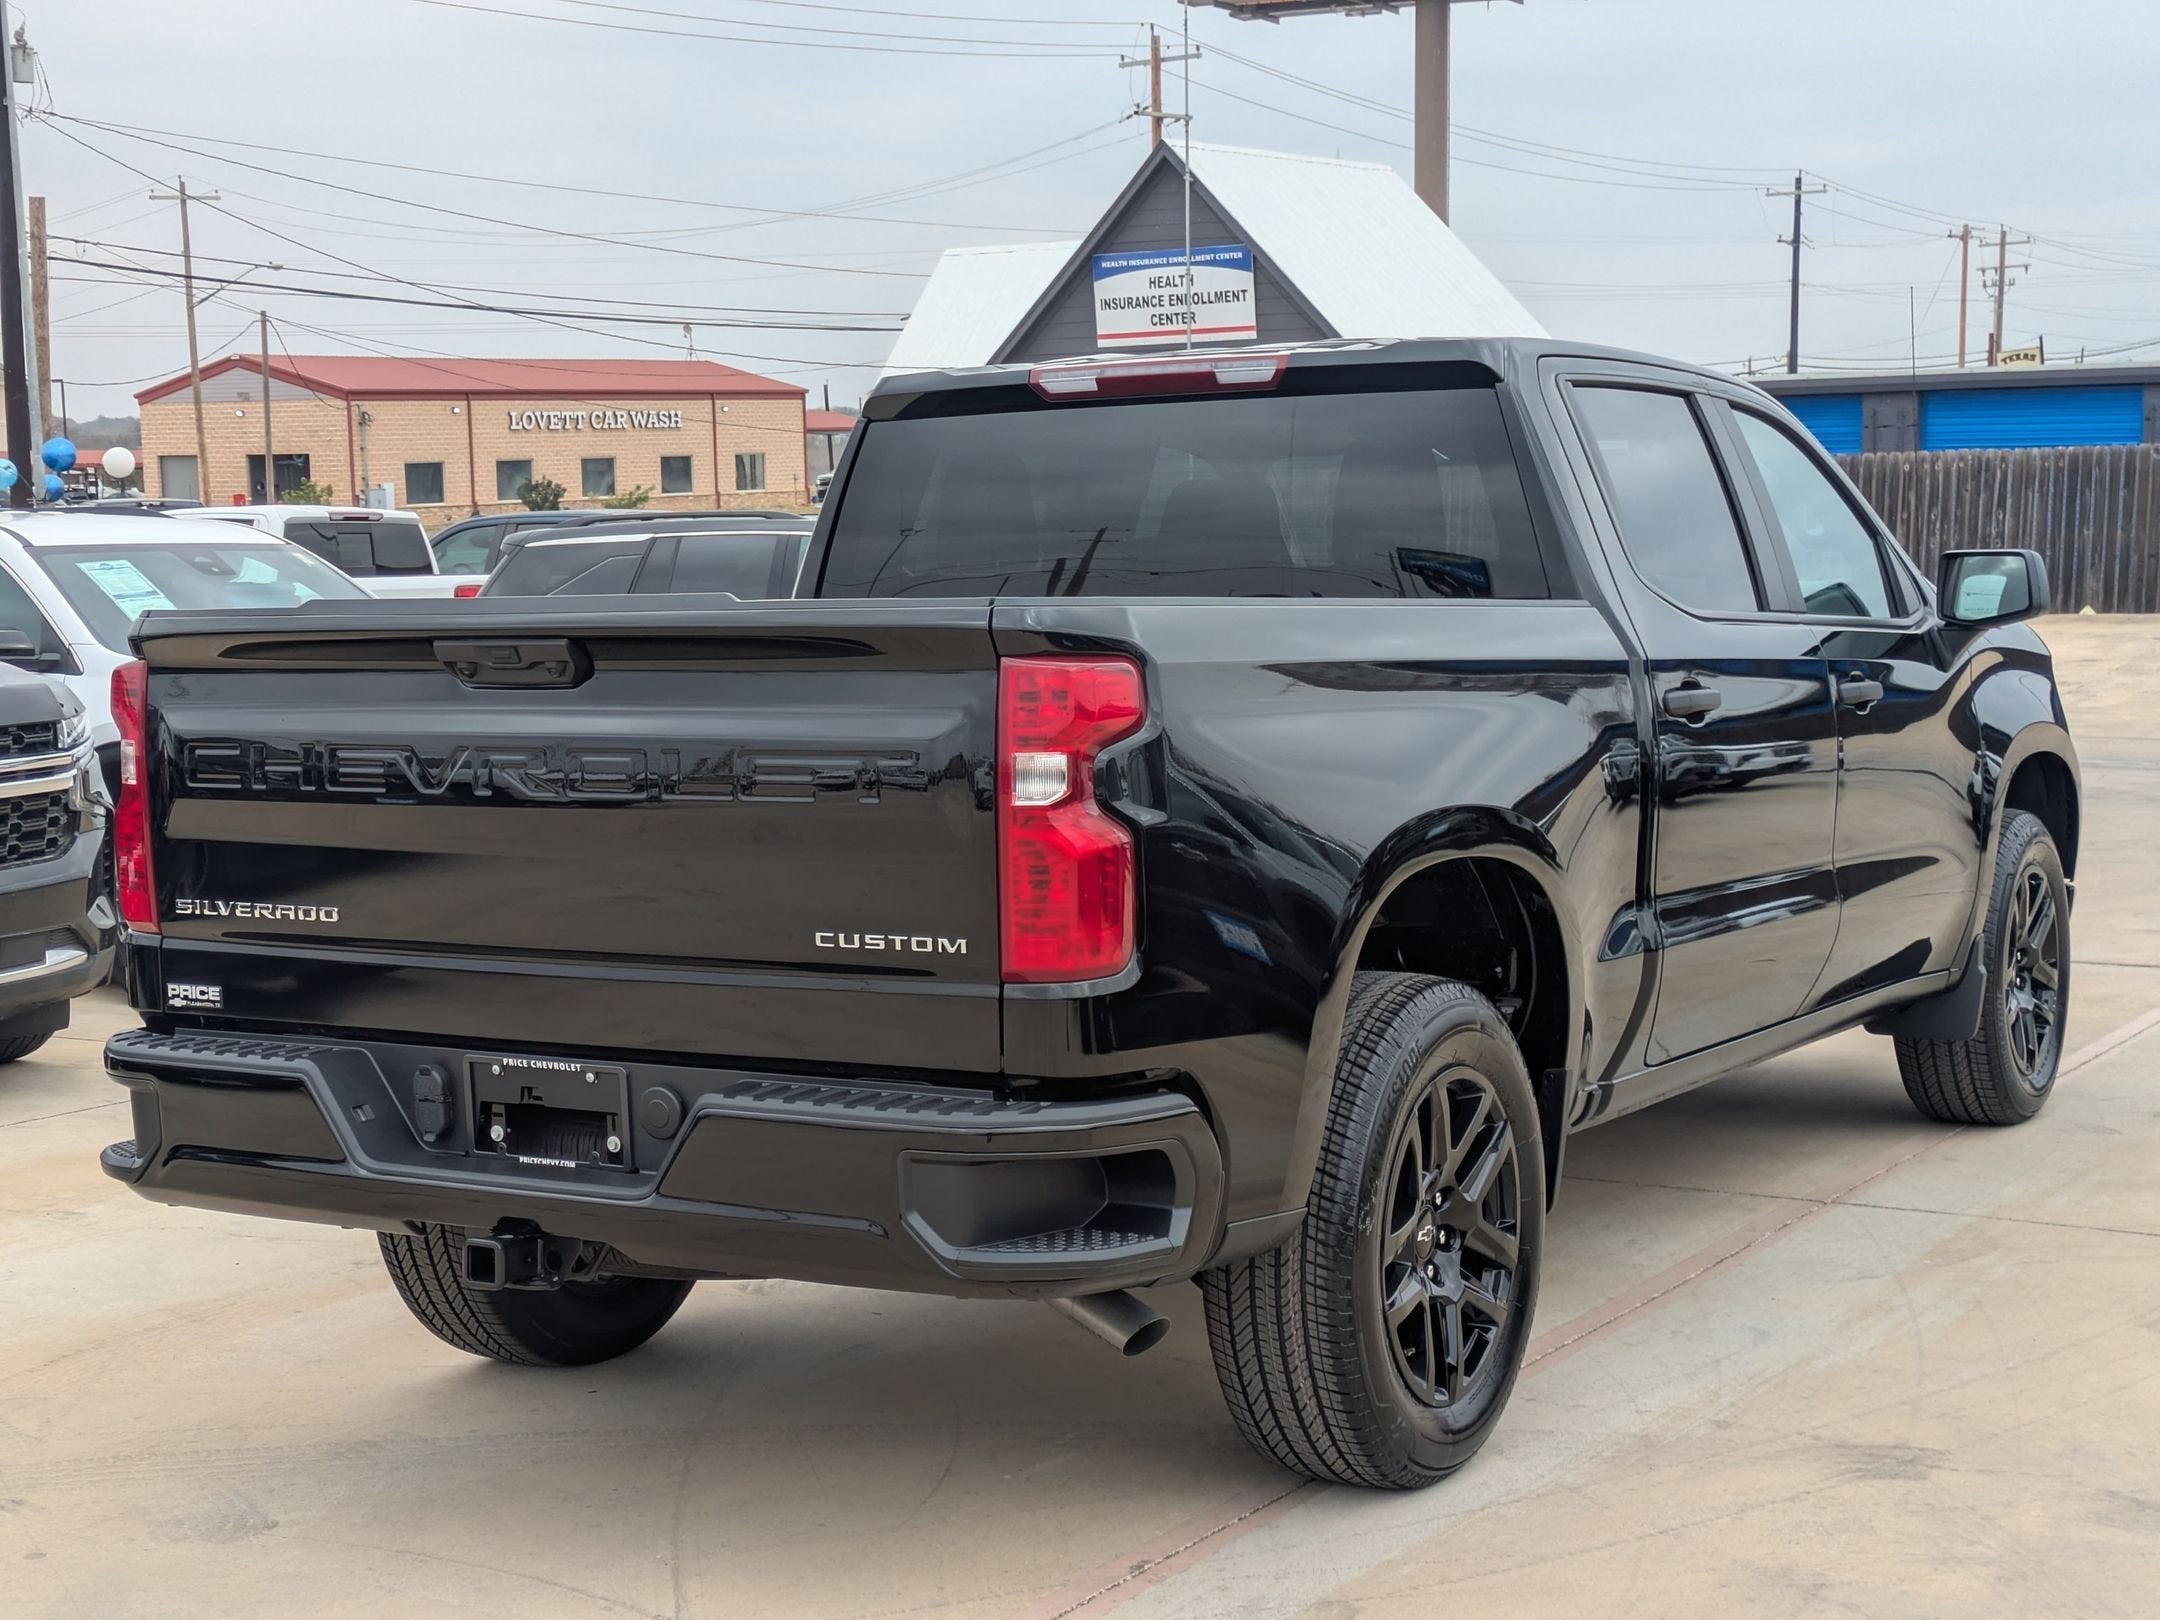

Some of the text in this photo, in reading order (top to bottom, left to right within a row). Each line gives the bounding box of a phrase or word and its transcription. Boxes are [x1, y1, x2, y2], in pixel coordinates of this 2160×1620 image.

[1101, 251, 1243, 269] HEALTH INSURANCE ENROLMENT CENTER
[1149, 274, 1194, 290] HEALTH
[1100, 294, 1165, 311] INSURANCE
[1150, 311, 1197, 327] CENTER
[2000, 352, 2037, 365] TEXAS
[509, 409, 683, 430] LOVETT CAR WASH
[182, 742, 921, 804] CHEVROLET
[175, 898, 339, 922] SILVERADO
[815, 931, 968, 954] CUSTOM
[167, 984, 221, 1001] PRICE
[502, 1058, 581, 1072] PRICE CHEVROLET
